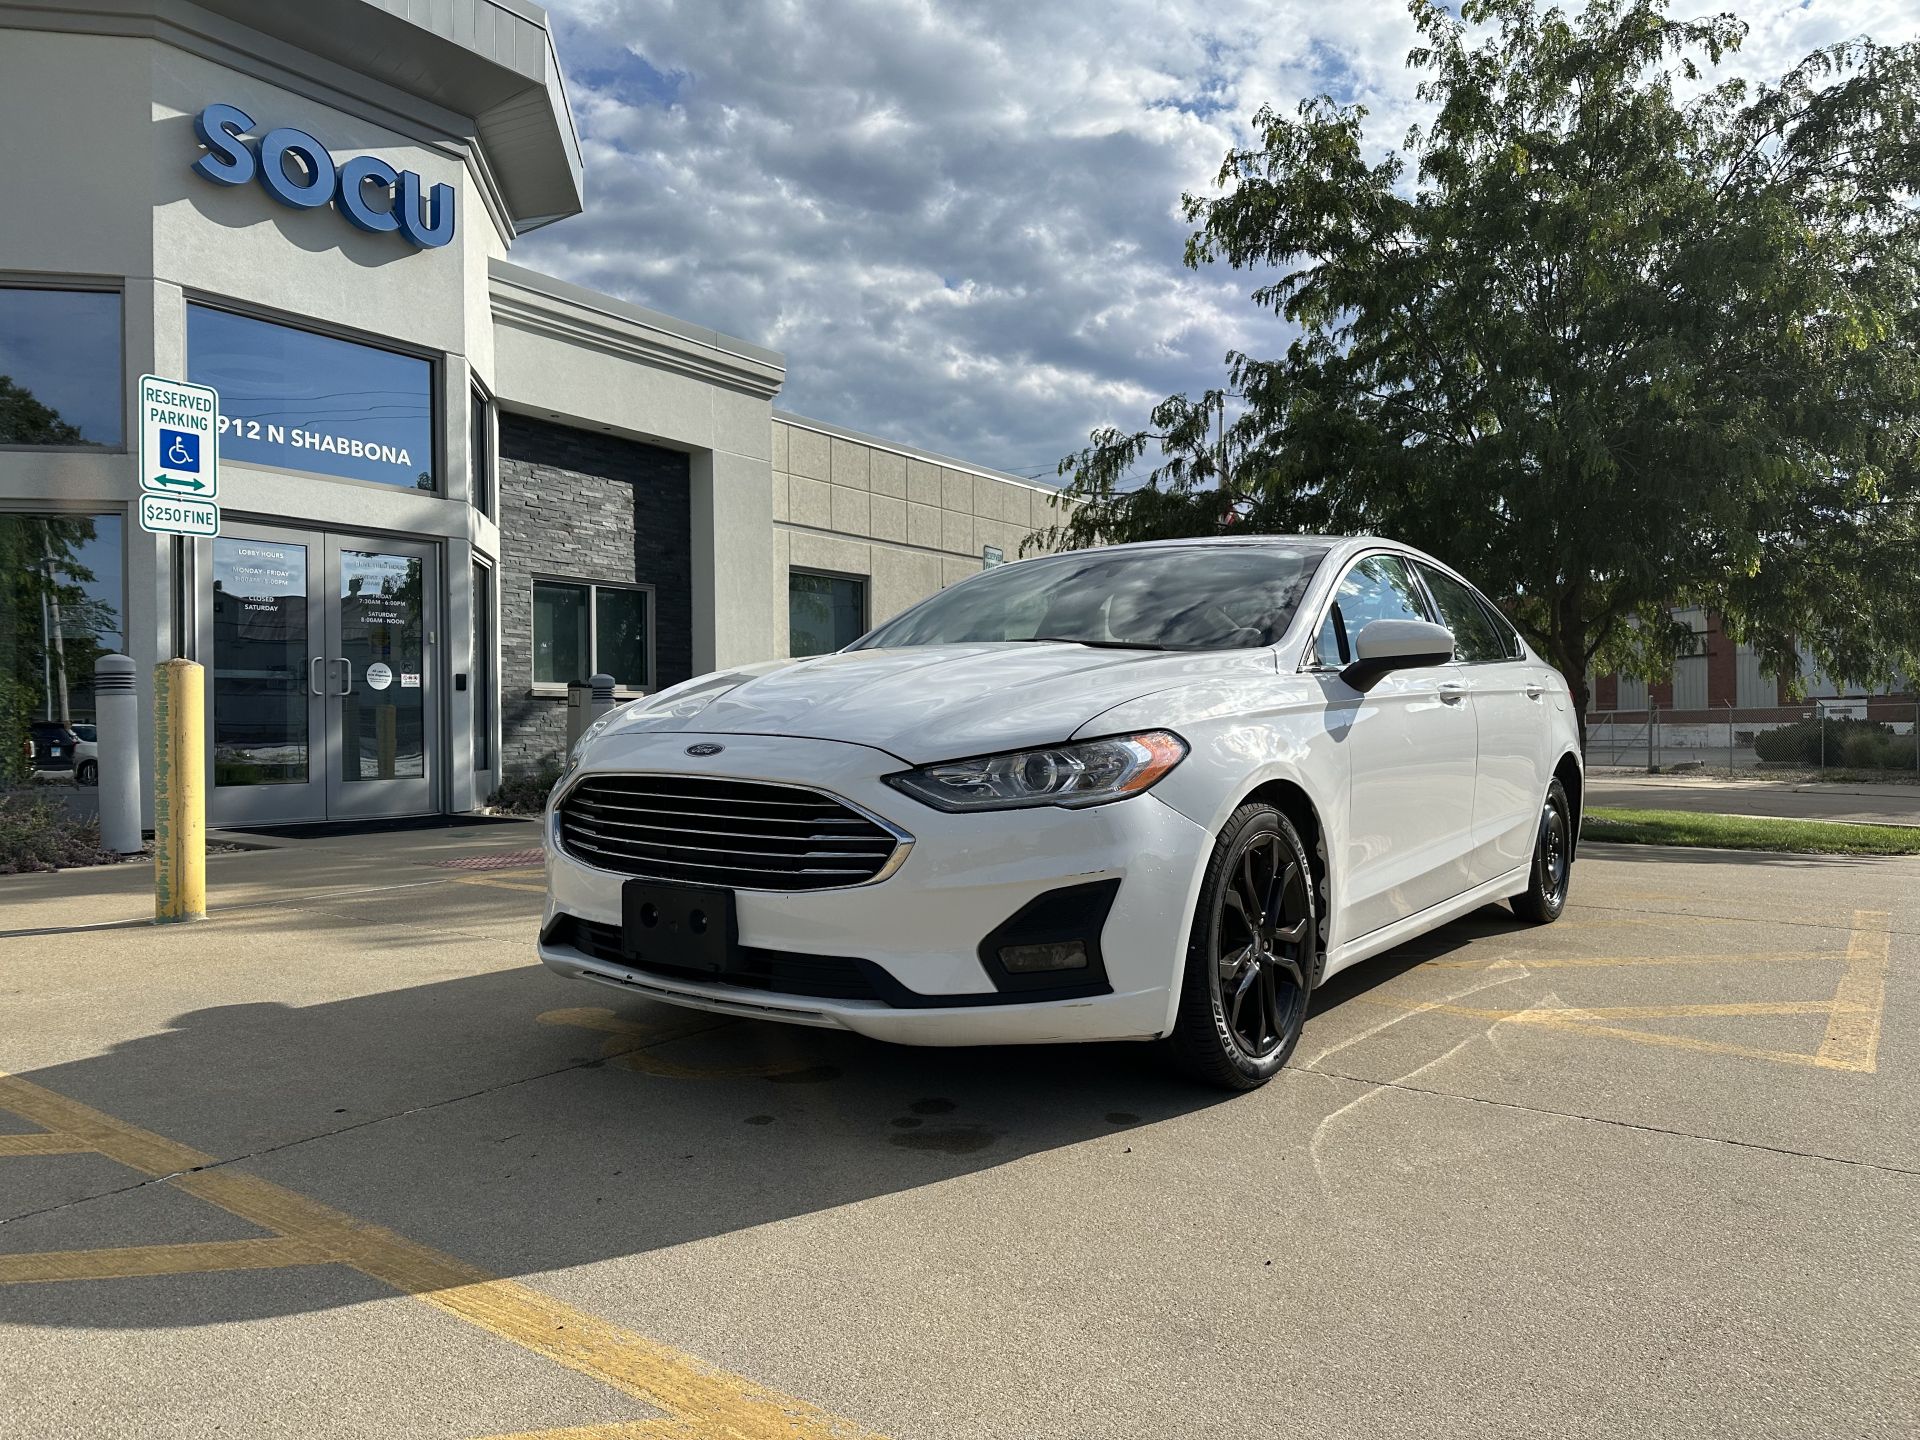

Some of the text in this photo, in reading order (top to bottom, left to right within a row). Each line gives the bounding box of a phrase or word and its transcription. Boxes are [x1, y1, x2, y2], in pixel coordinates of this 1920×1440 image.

[191, 103, 455, 249] SOCU
[146, 387, 212, 412] RESERVED
[150, 408, 208, 431] PARKING
[218, 415, 412, 467] 912 N SHABBONA
[146, 504, 213, 526] $250 FINE
[238, 548, 284, 559] LOBBY HOURS
[232, 566, 262, 575] MONDAY
[266, 569, 289, 577] FRIDAY
[244, 604, 278, 612] SATURDAY
[248, 595, 274, 603] CLOSED
